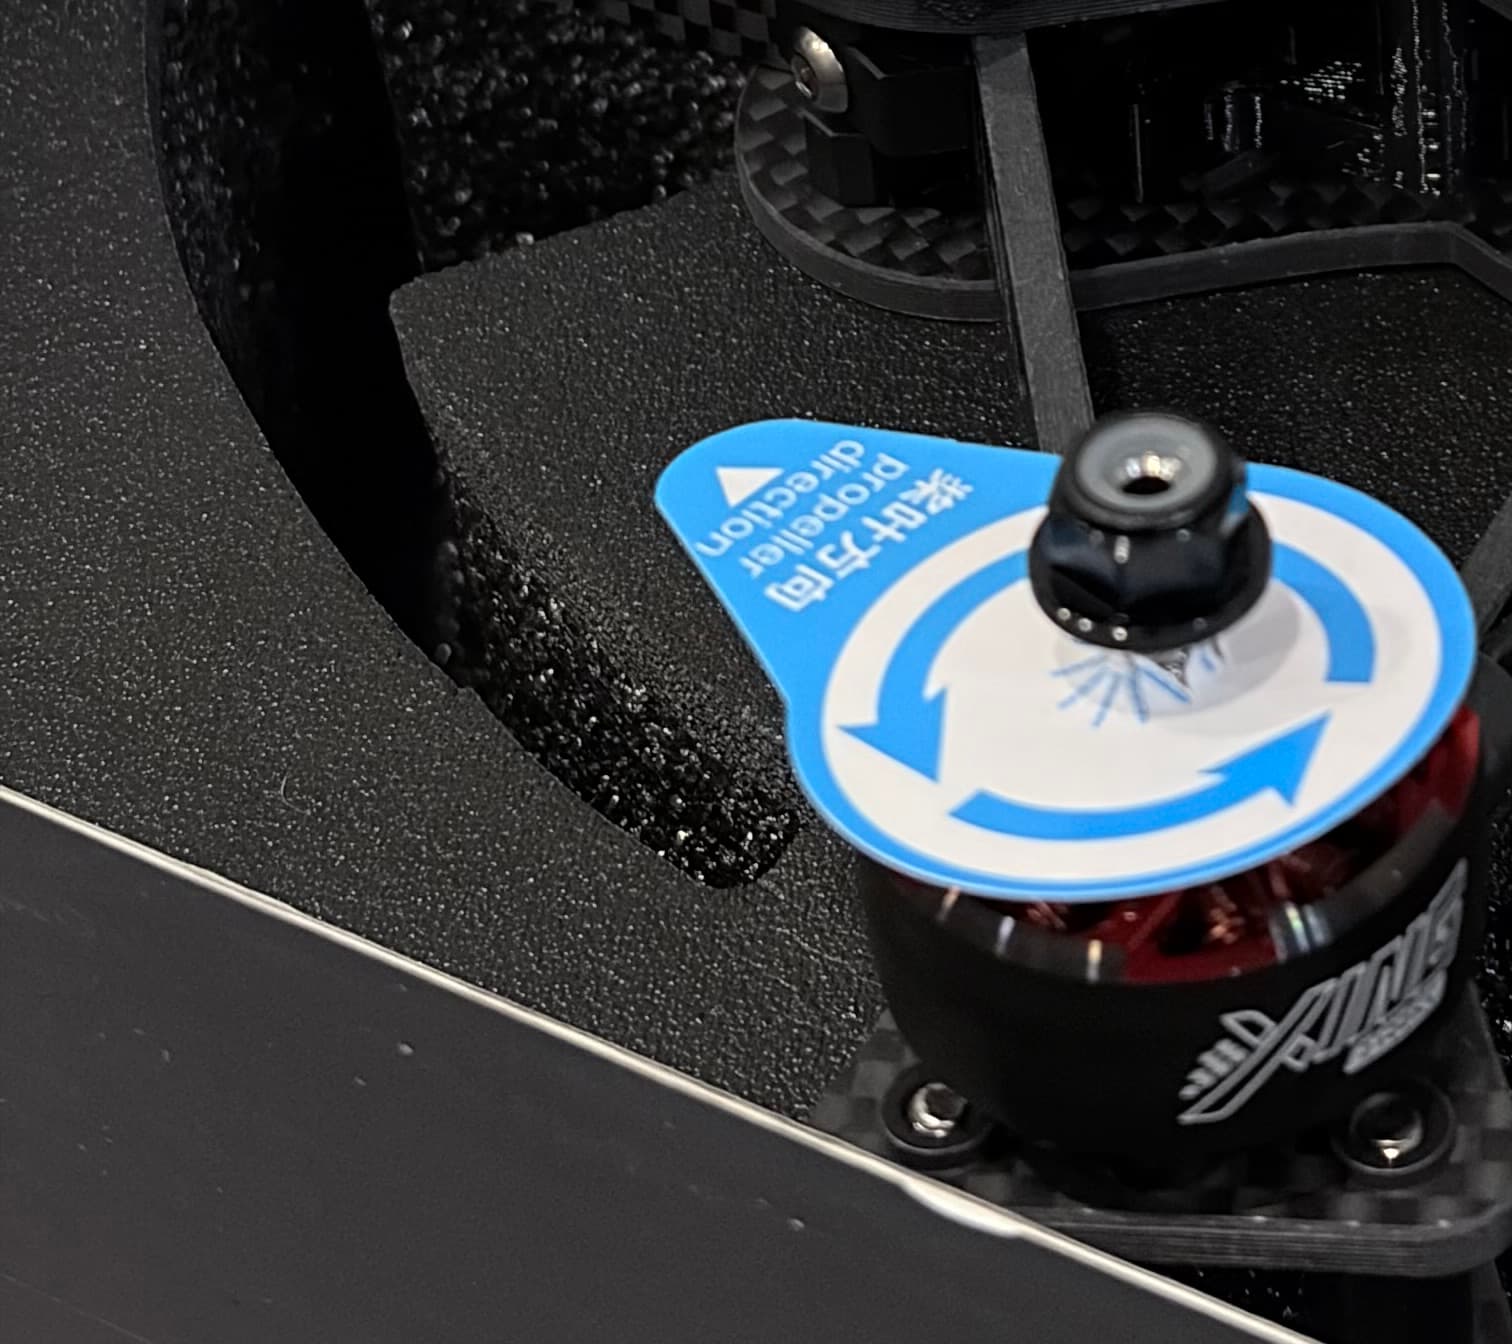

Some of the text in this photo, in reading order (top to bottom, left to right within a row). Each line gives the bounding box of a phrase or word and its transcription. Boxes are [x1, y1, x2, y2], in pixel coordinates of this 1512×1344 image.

[694, 439, 866, 558] direction
[739, 452, 910, 579] propeller
[763, 468, 974, 613] 桨叶方向
